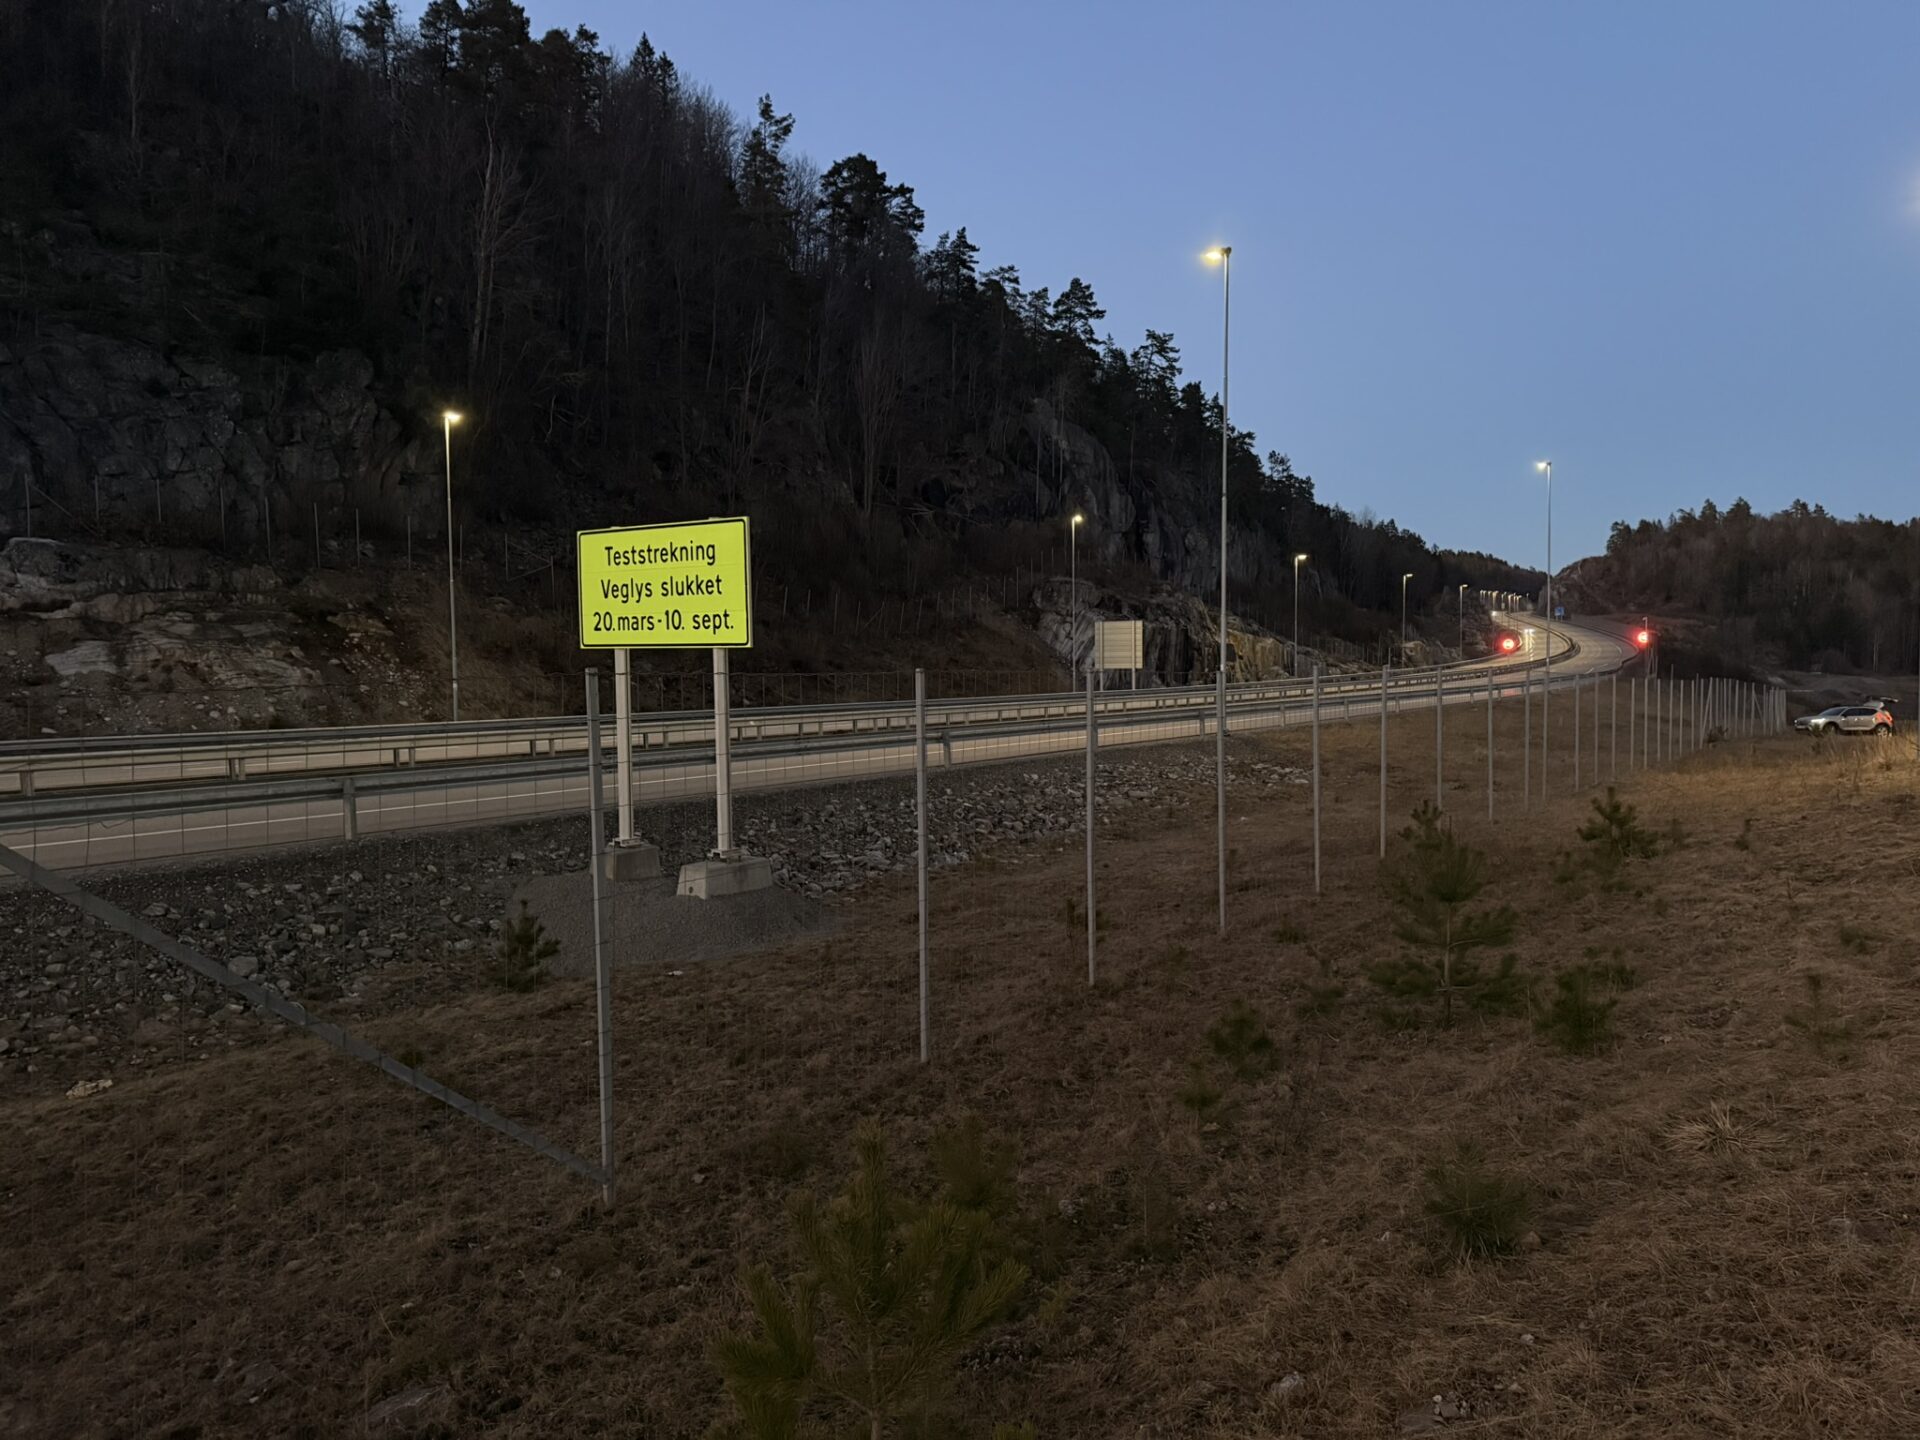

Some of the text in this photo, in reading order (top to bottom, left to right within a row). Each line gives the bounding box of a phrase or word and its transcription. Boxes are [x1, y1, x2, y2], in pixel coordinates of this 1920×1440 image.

[604, 540, 716, 567] Teststrekning
[600, 574, 723, 604] Veglys slukket
[691, 608, 734, 635] sept.
